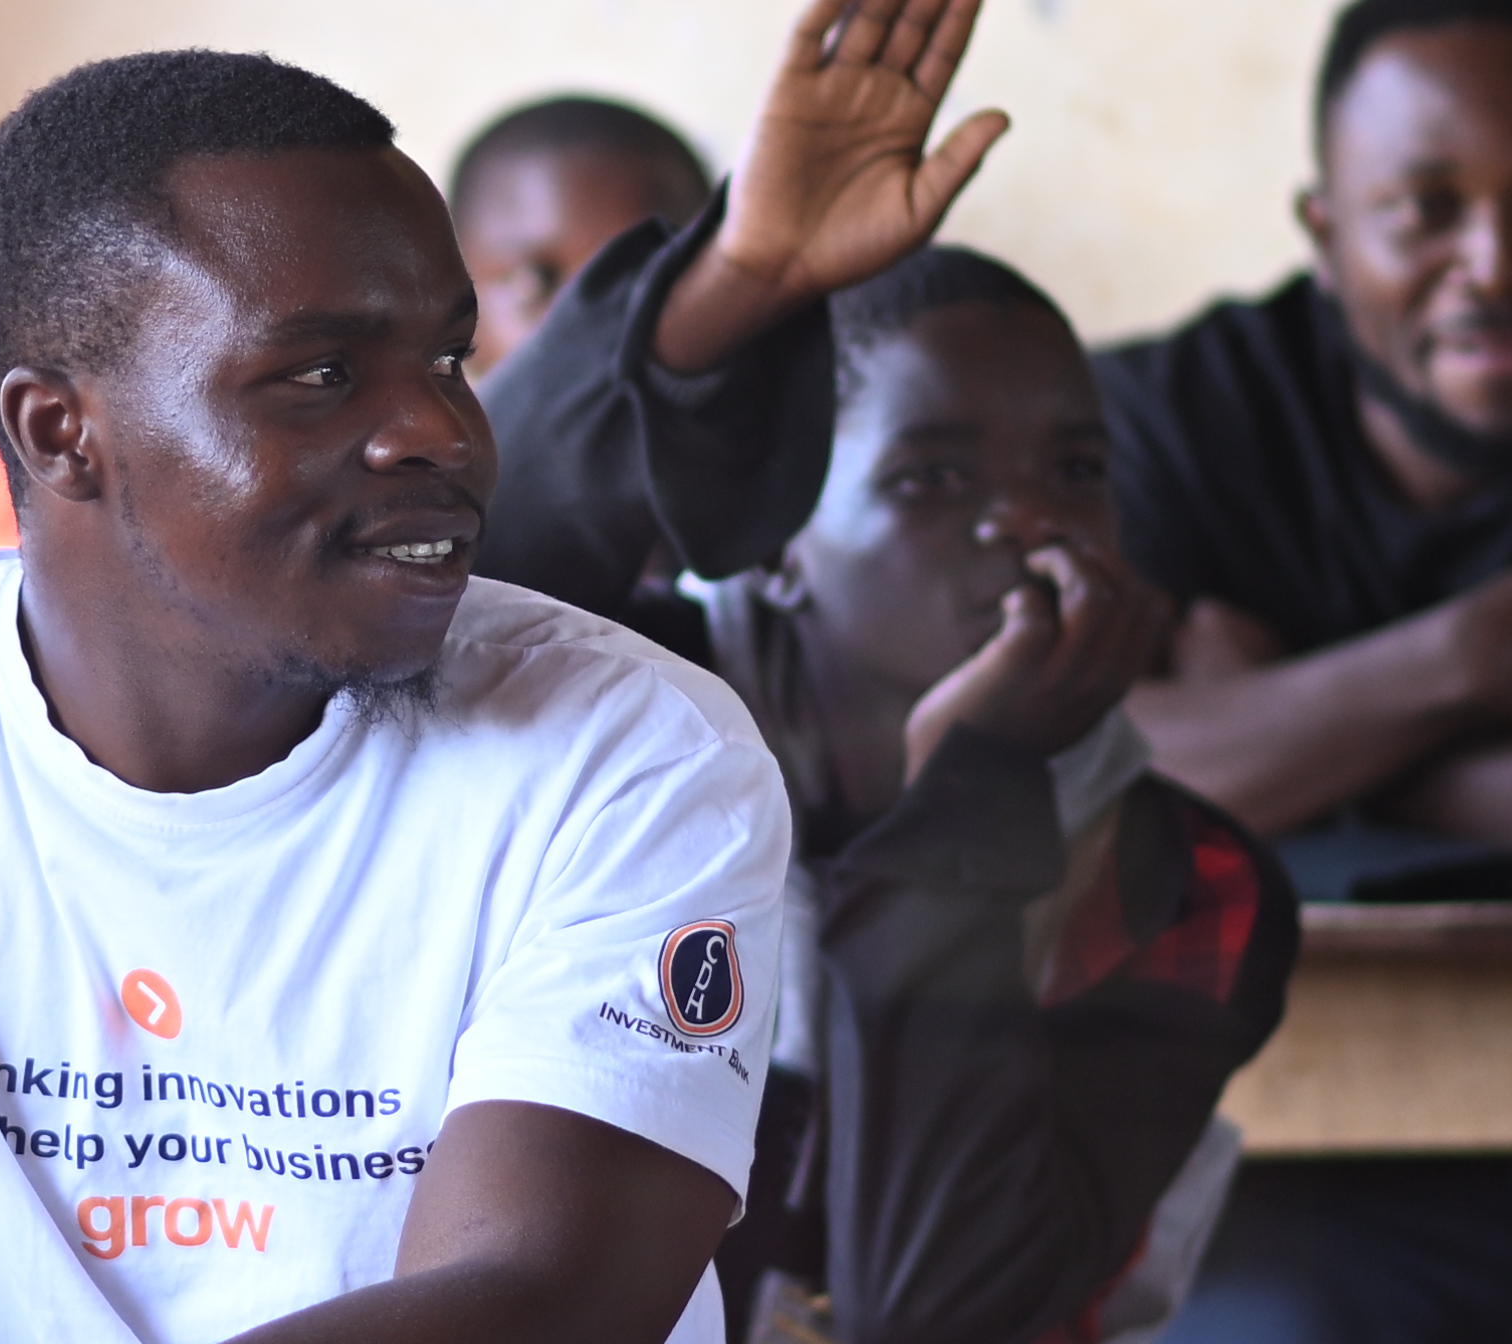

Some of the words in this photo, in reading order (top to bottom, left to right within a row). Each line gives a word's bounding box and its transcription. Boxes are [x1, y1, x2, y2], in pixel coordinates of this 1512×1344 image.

[685, 935, 724, 1020] CDH
[599, 1002, 726, 1056] INVESTMENT
[728, 1047, 749, 1085] BANK
[142, 1064, 401, 1118] innovations
[124, 1131, 232, 1169] your
[245, 1133, 435, 1181] busines
[77, 1194, 275, 1260] grow
